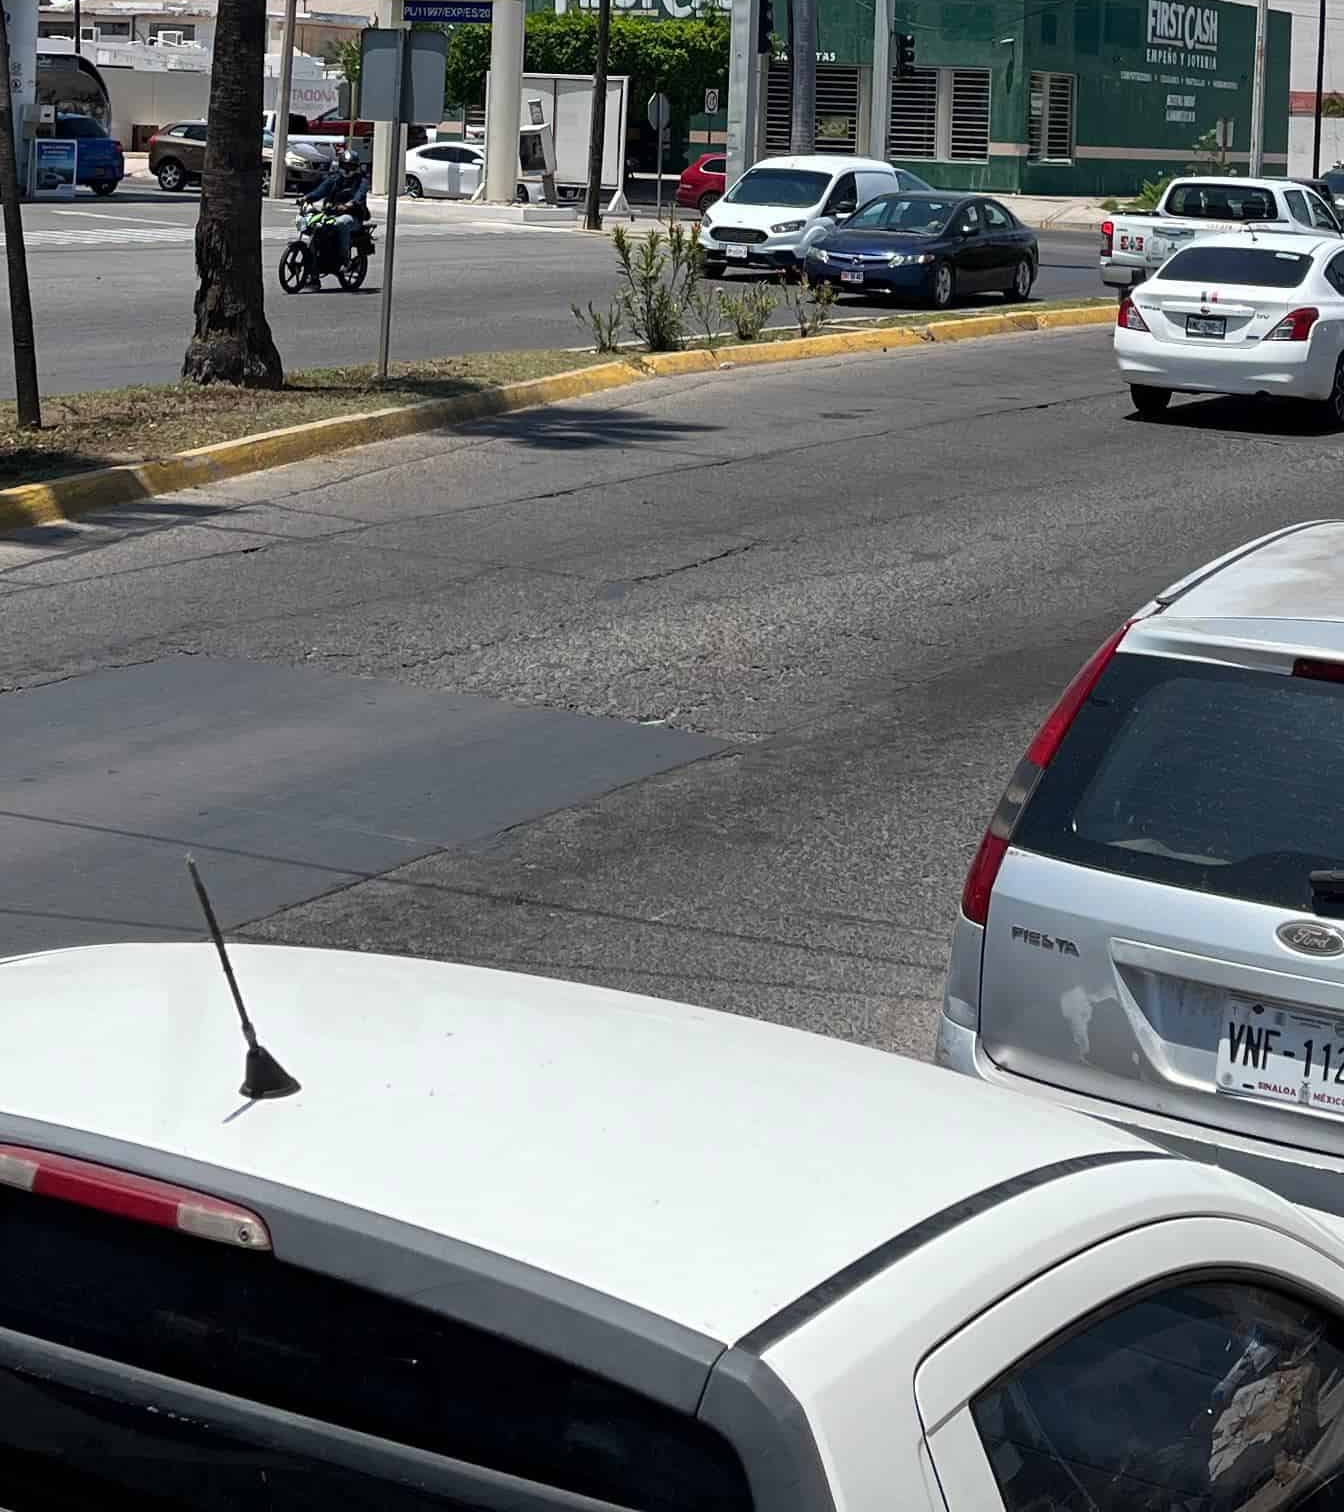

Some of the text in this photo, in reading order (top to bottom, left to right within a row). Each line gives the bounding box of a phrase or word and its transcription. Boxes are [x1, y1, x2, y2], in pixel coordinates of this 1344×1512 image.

[1147, 0, 1218, 49] FIRST CASH
[1146, 47, 1177, 65] EMPEÑO
[1179, 52, 1185, 66] Y
[1011, 925, 1080, 958] FIESTA
[1293, 928, 1331, 948] Ford
[1257, 1081, 1297, 1098] SINALOA
